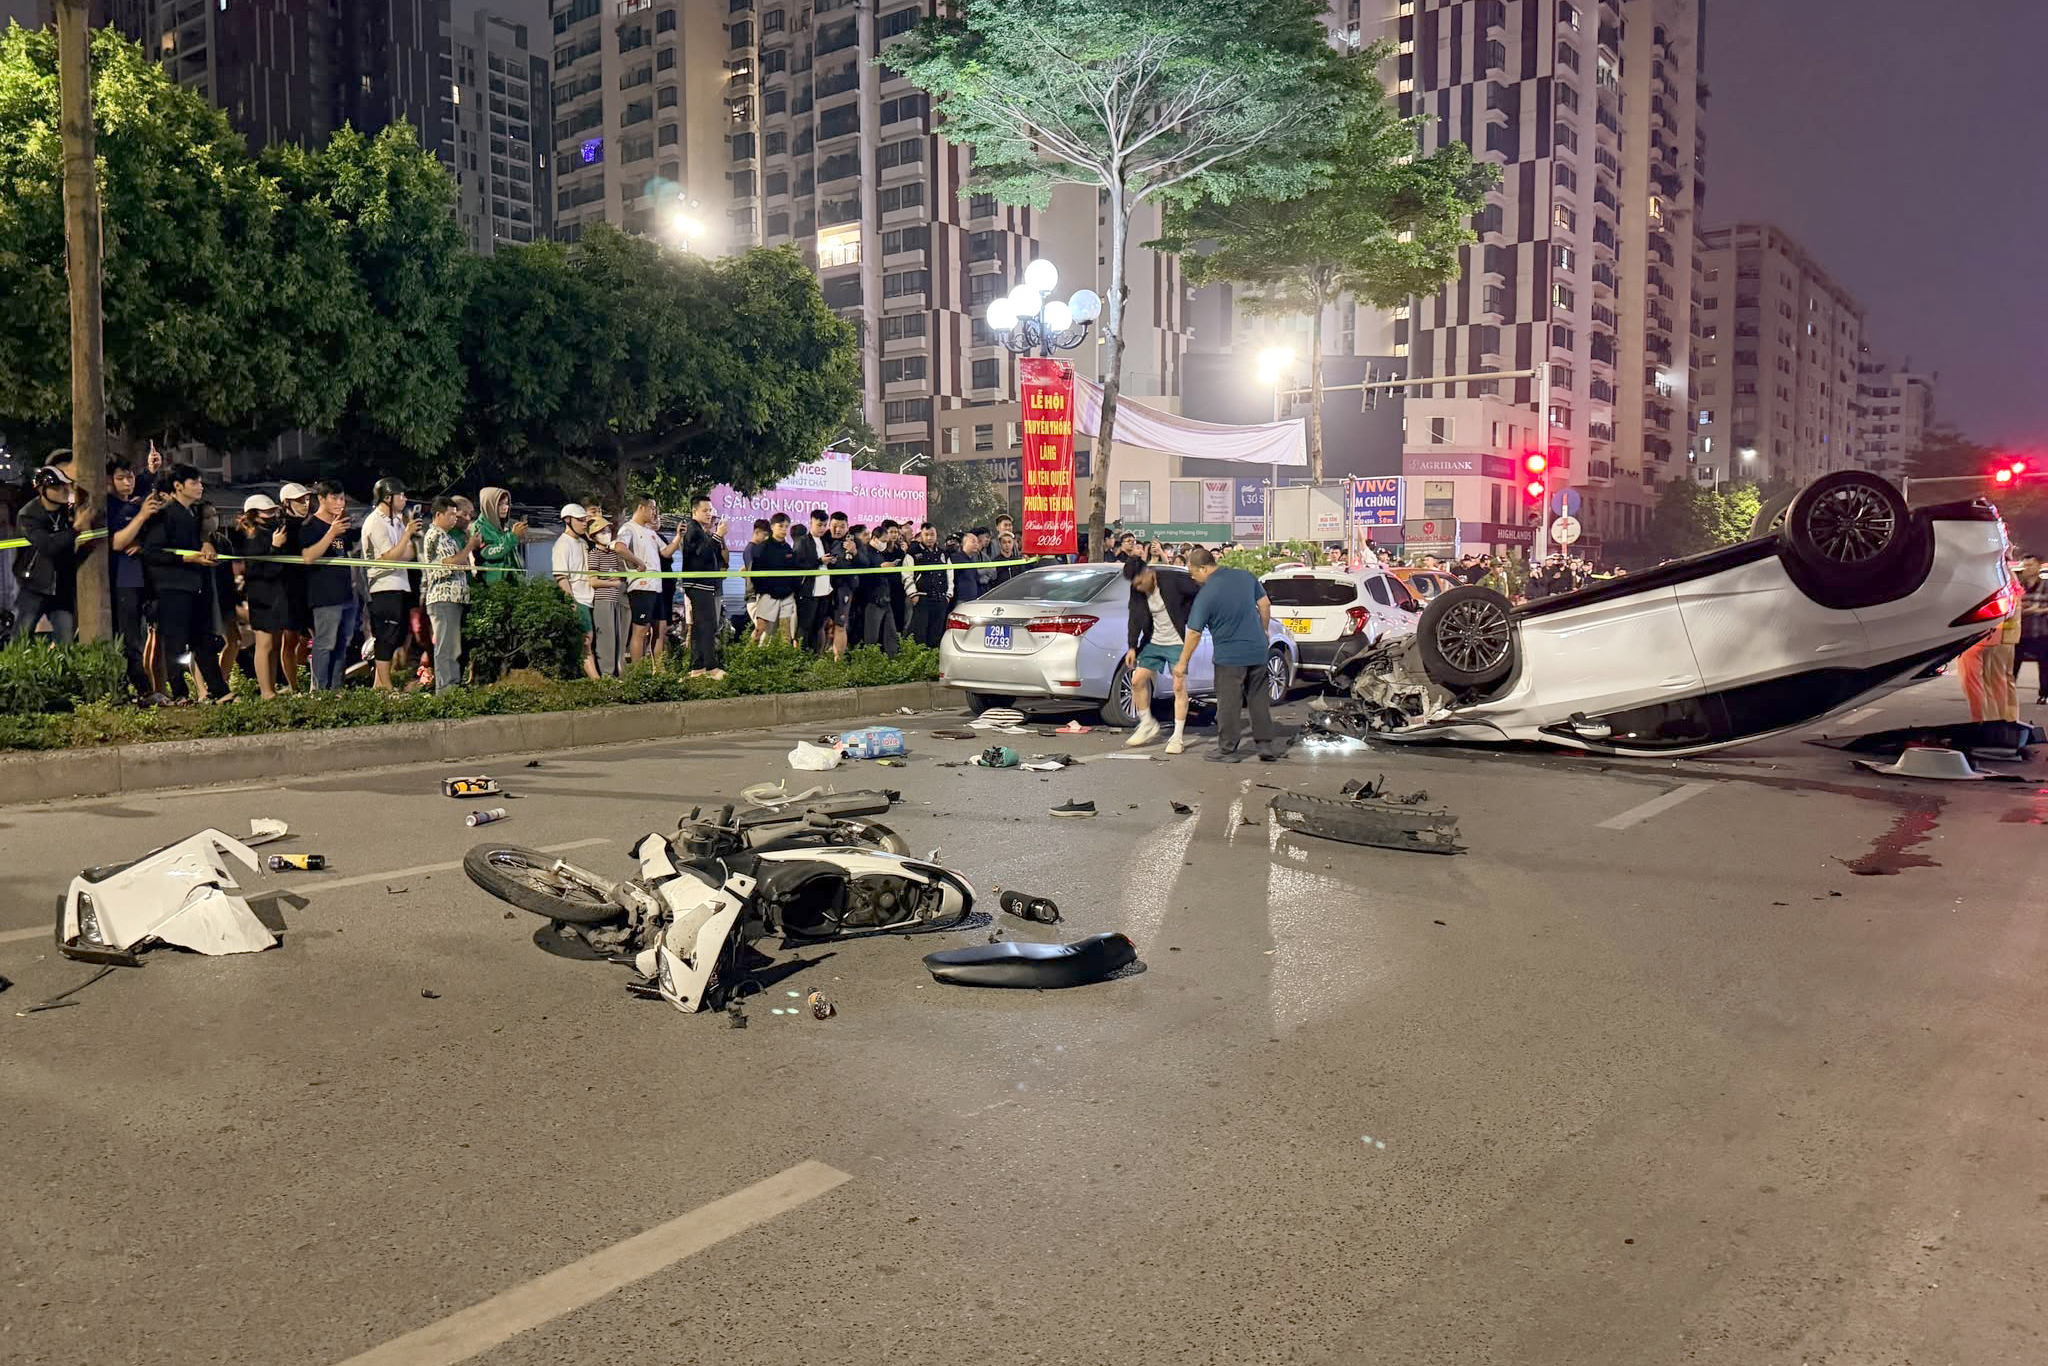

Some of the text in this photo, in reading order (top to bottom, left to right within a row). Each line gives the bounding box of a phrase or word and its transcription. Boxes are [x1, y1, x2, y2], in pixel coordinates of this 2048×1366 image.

[1030, 389, 1065, 412] LỄ HỘI
[1040, 442, 1057, 460] LÀNG
[799, 465, 827, 476] vices
[1420, 461, 1472, 470] AGRIBANK
[852, 484, 925, 500] SÀI GÒN MOTOR
[1355, 479, 1397, 493] VNVC
[751, 492, 780, 511] GÒN
[783, 499, 829, 514] MOTOR
[1036, 534, 1062, 546] 2026
[1497, 529, 1532, 541] HIGHLANDS
[990, 625, 1005, 637] 29A
